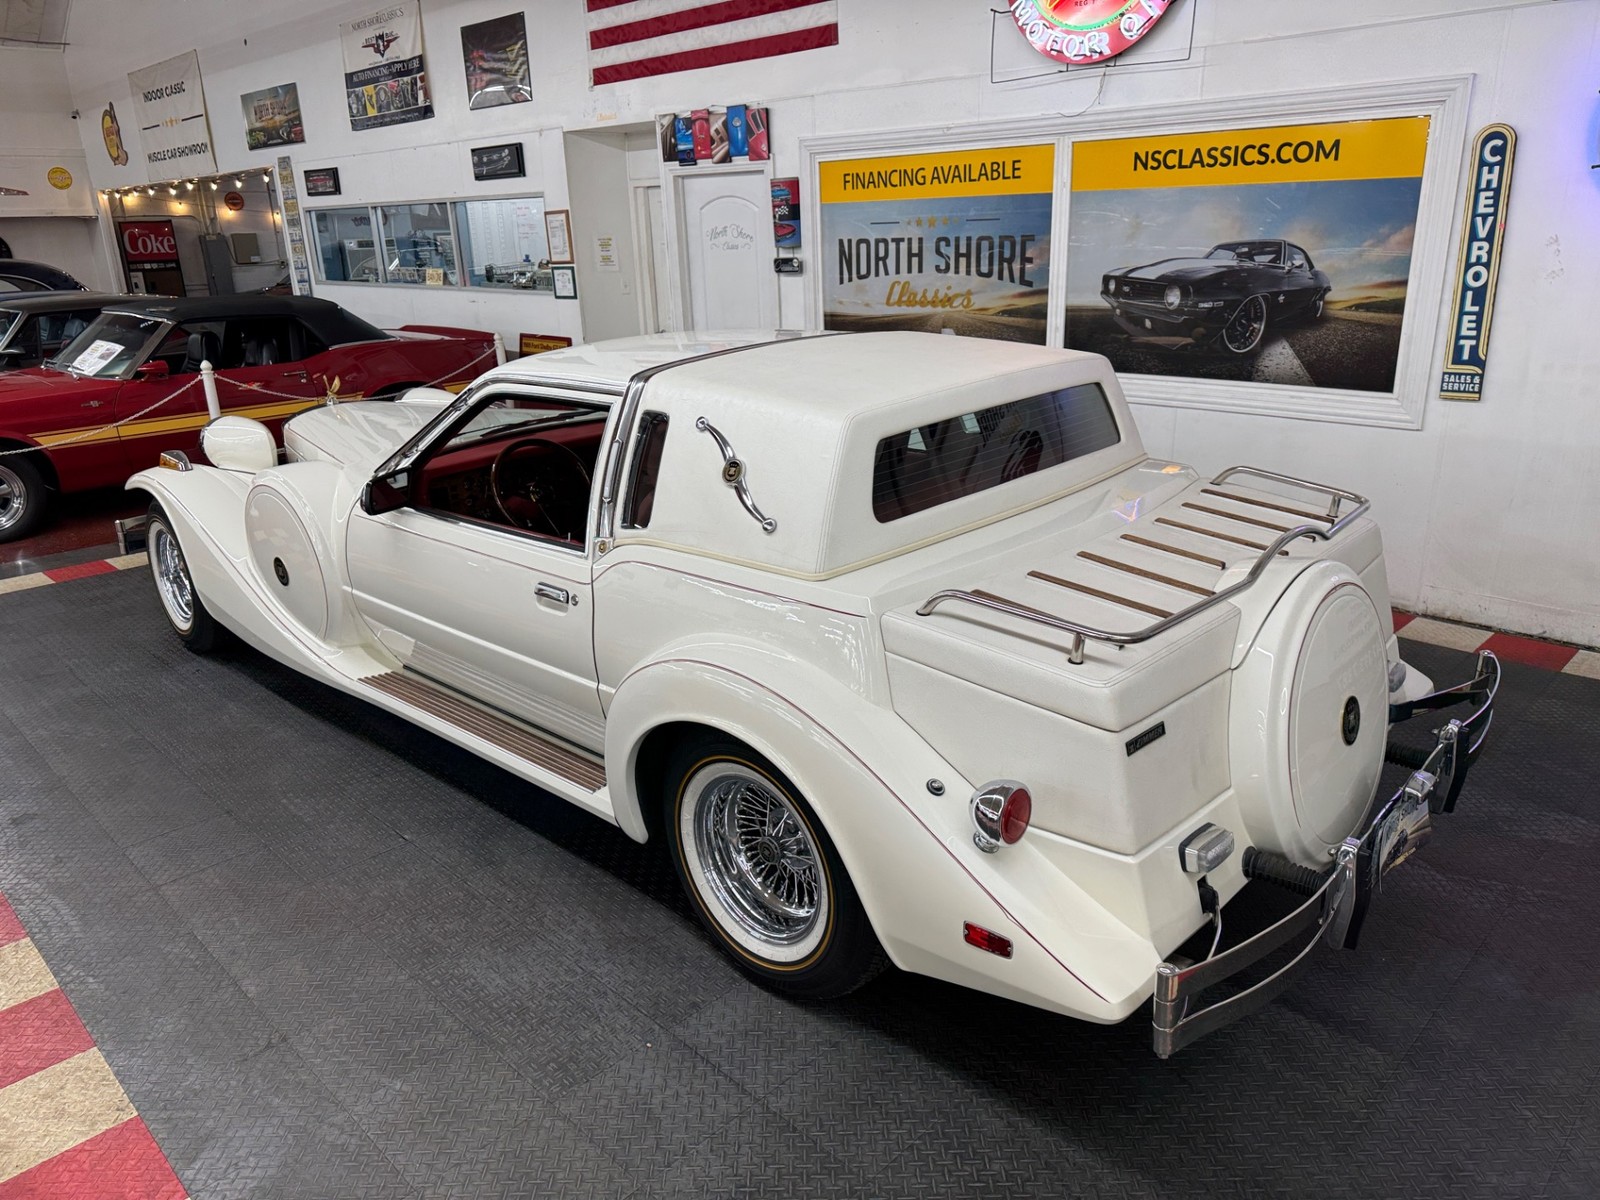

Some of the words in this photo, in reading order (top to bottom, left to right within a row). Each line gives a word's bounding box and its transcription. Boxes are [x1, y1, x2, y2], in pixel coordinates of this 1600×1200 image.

[1133, 138, 1341, 171] NSCLASSICS.COM
[842, 167, 926, 191] FINANCING
[930, 159, 1022, 185] AVAILABLE
[123, 229, 177, 255] Coke
[1458, 138, 1504, 361] CHEVROLET
[838, 236, 924, 285] NORTH
[934, 234, 1036, 288] SHORE
[885, 280, 975, 309] Classics
[1442, 382, 1480, 392] SERVICE
[1443, 374, 1471, 383] SALES
[1473, 375, 1481, 384] &
